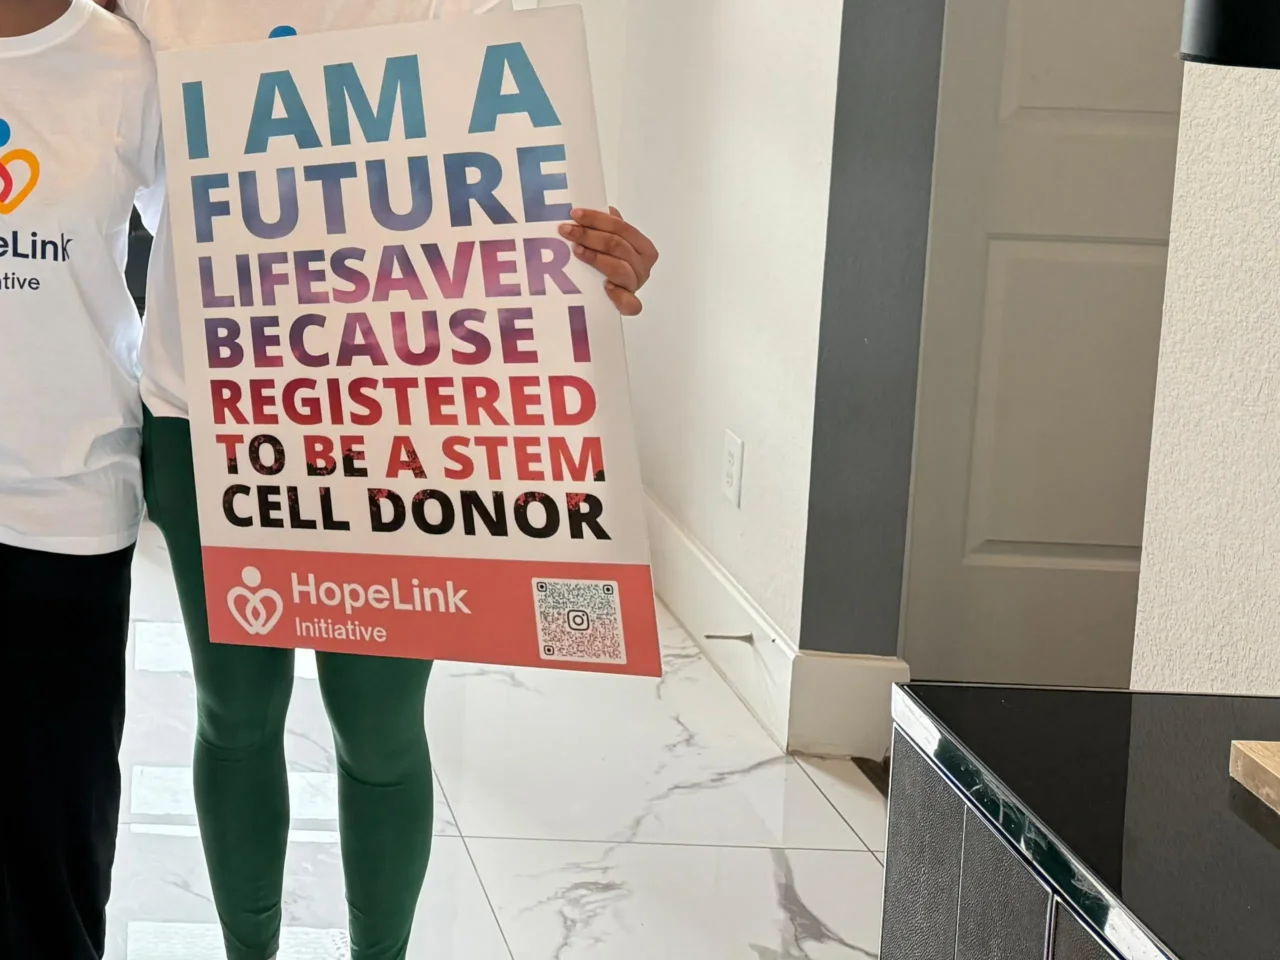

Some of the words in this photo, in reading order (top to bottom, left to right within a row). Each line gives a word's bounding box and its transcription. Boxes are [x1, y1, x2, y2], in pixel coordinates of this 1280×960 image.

[182, 81, 209, 159] I
[244, 54, 427, 154] AM
[468, 42, 561, 134] A
[191, 144, 573, 243] FUTURE
[199, 238, 582, 308] LIFESAVER
[204, 307, 538, 369] BECAUSE
[568, 305, 591, 363] I
[209, 375, 597, 426] REGISTERED
[216, 434, 286, 476] TO
[303, 435, 368, 477] BE
[385, 436, 427, 479] A
[442, 436, 606, 482] STEM
[222, 483, 350, 531] CELL
[367, 488, 612, 540] DONOR
[291, 572, 472, 614] HopeLink
[295, 617, 387, 642] Initiative
